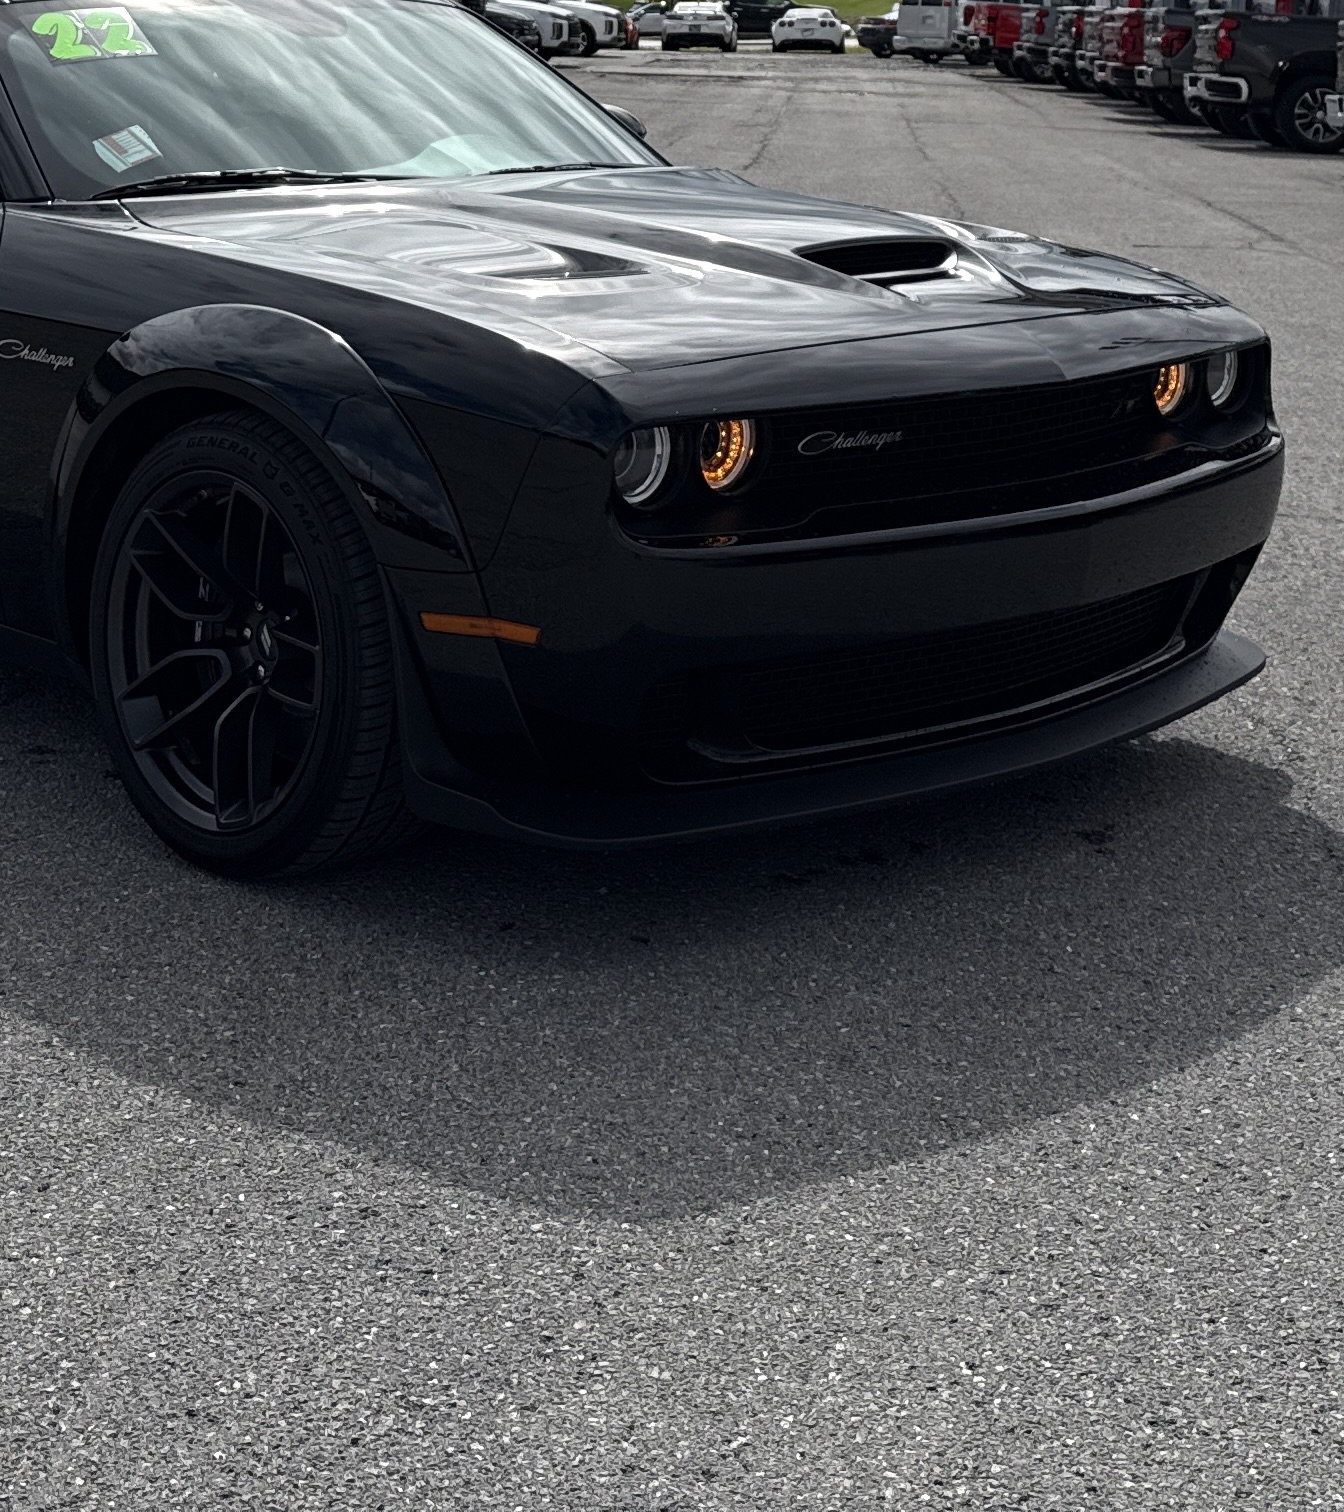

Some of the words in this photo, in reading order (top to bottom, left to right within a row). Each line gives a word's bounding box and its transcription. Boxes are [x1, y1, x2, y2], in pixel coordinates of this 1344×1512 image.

[32, 11, 153, 60] 22
[185, 435, 261, 466] GENERAL
[797, 430, 904, 456] Challenger
